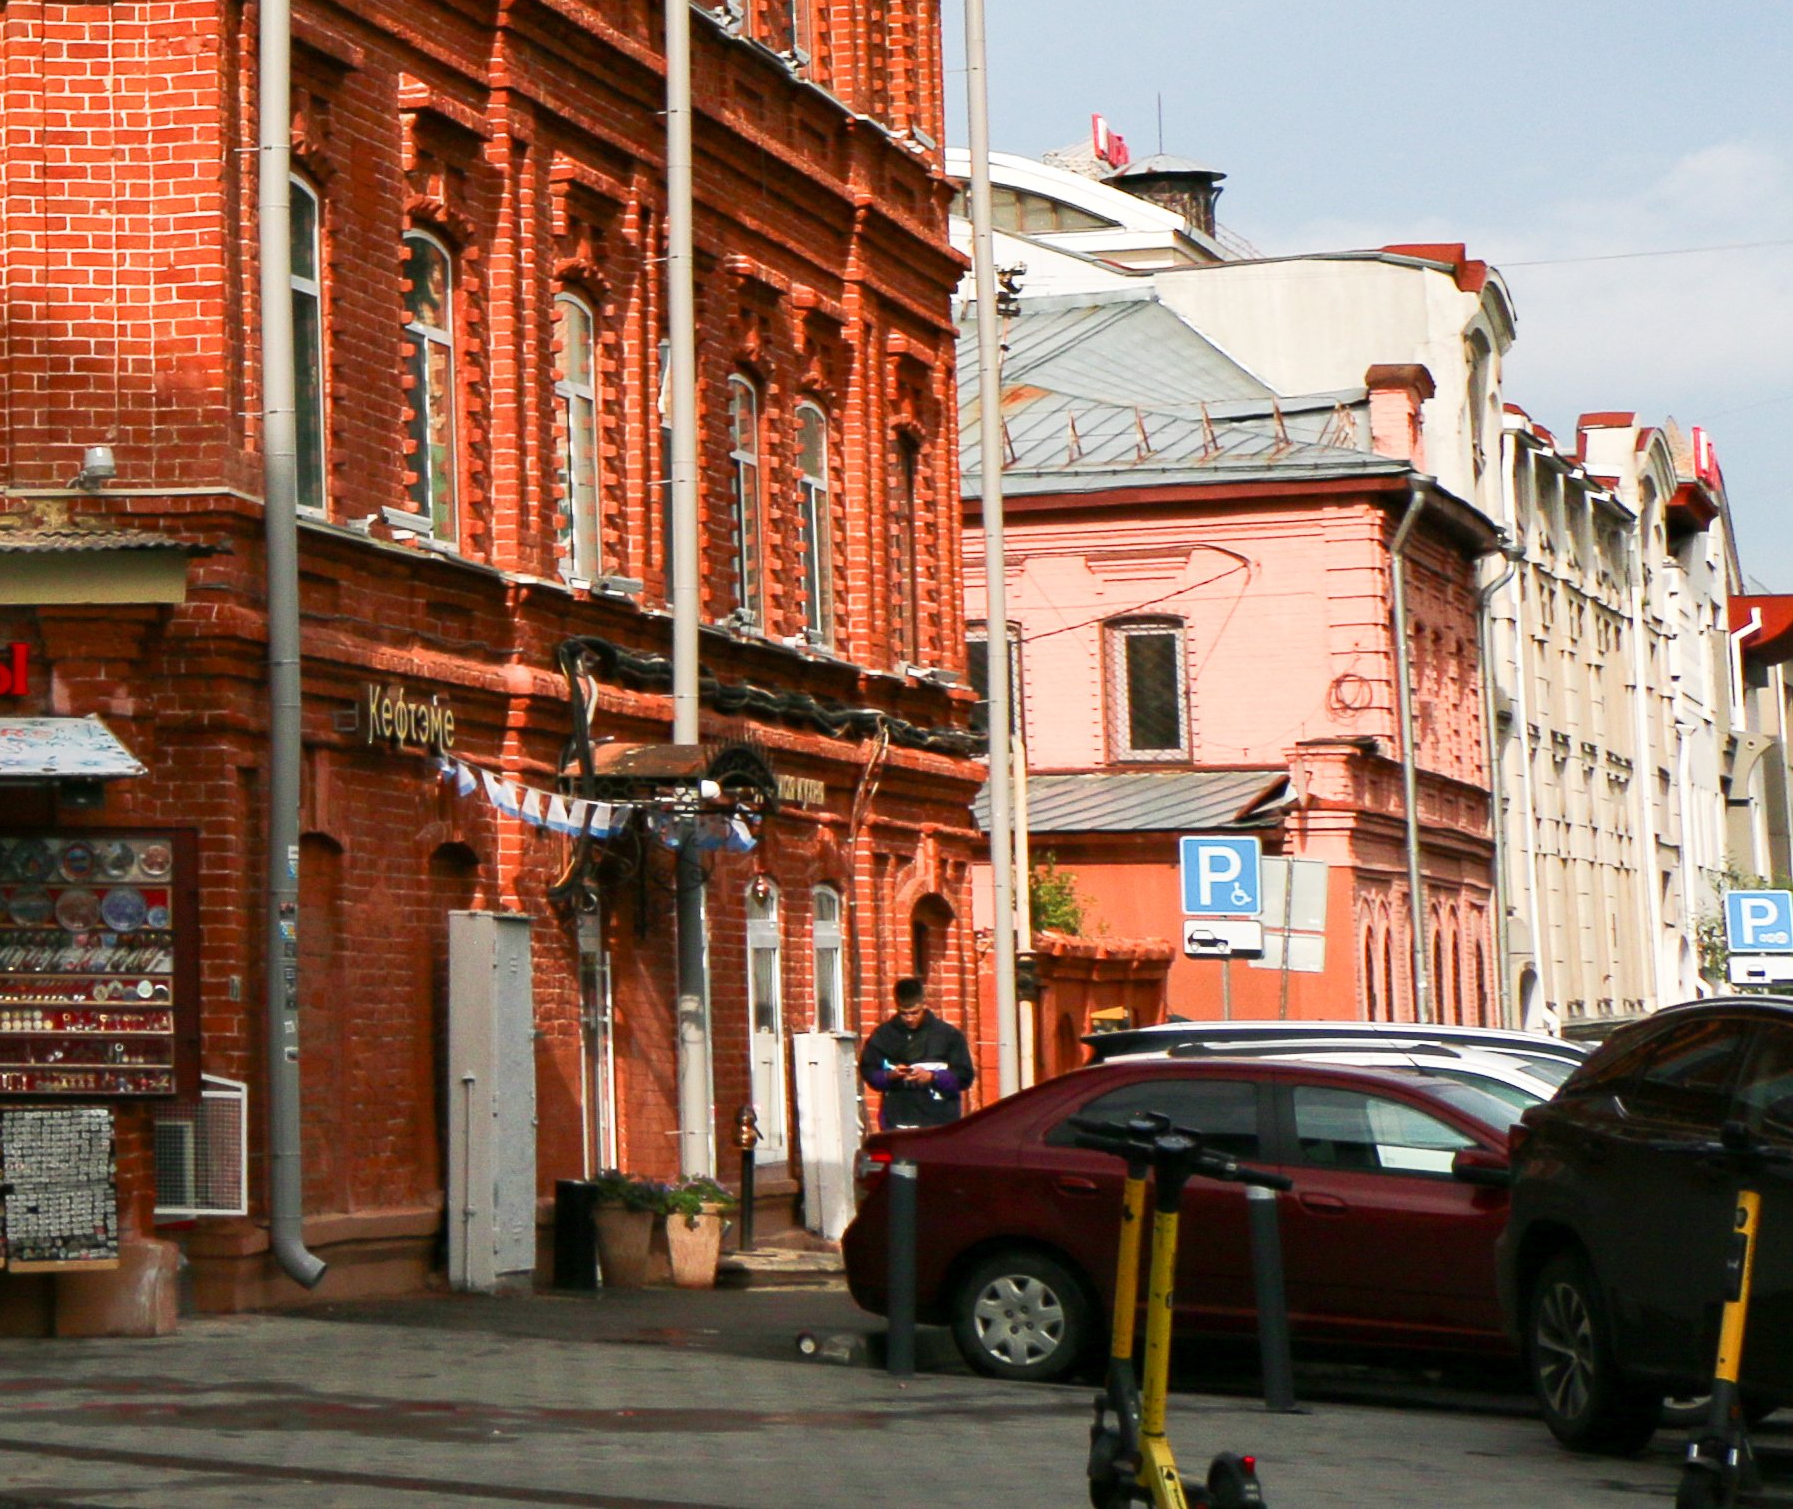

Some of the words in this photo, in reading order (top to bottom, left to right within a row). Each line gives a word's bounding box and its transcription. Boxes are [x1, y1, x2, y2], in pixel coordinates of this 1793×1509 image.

[368, 683, 455, 749] Кефтэме
[1198, 845, 1242, 906] P
[1740, 897, 1779, 945] P
